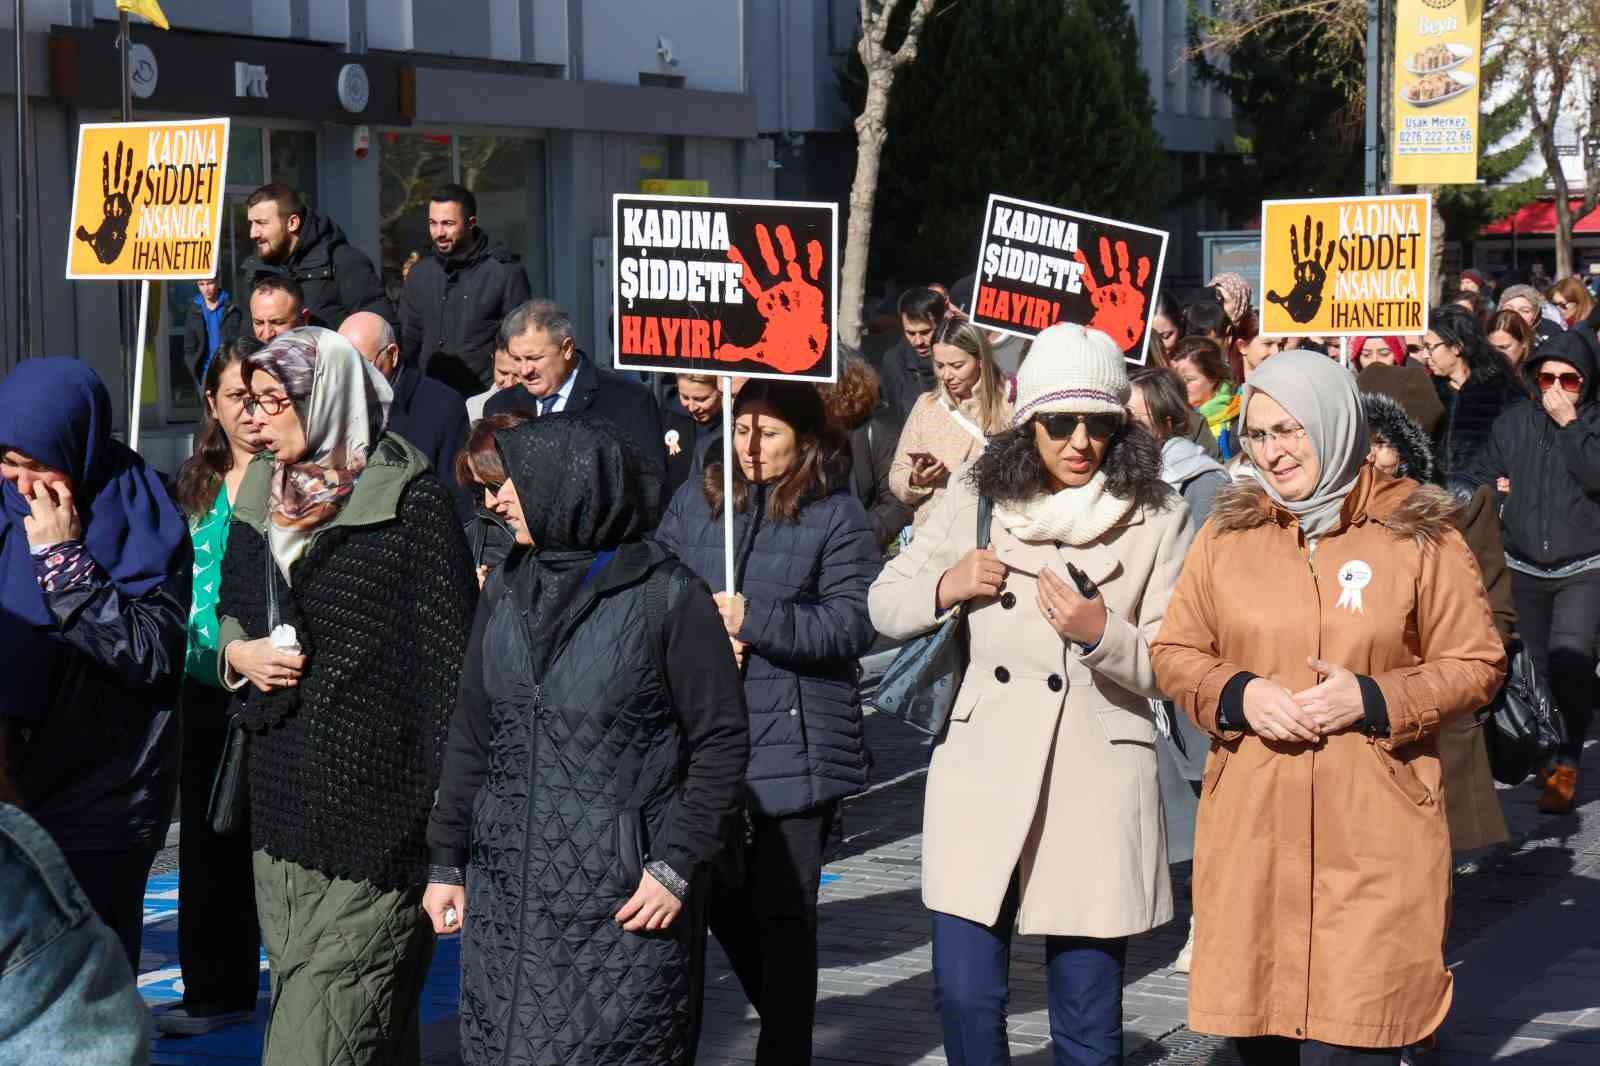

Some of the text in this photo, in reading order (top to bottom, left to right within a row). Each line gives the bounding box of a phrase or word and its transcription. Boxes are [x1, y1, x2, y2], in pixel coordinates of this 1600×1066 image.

[147, 128, 217, 169] KADINA
[623, 208, 730, 250] KADINA
[992, 206, 1079, 252] KADINA
[1338, 204, 1421, 239] KADINA
[132, 232, 212, 270] İHANETTİR
[983, 239, 1084, 294] ŞİDDETE
[620, 248, 743, 308] ŞİDDETE
[977, 286, 1060, 328] HAYIR!
[1331, 294, 1421, 328] İHANETTİR
[621, 316, 721, 358] HAYIR!
